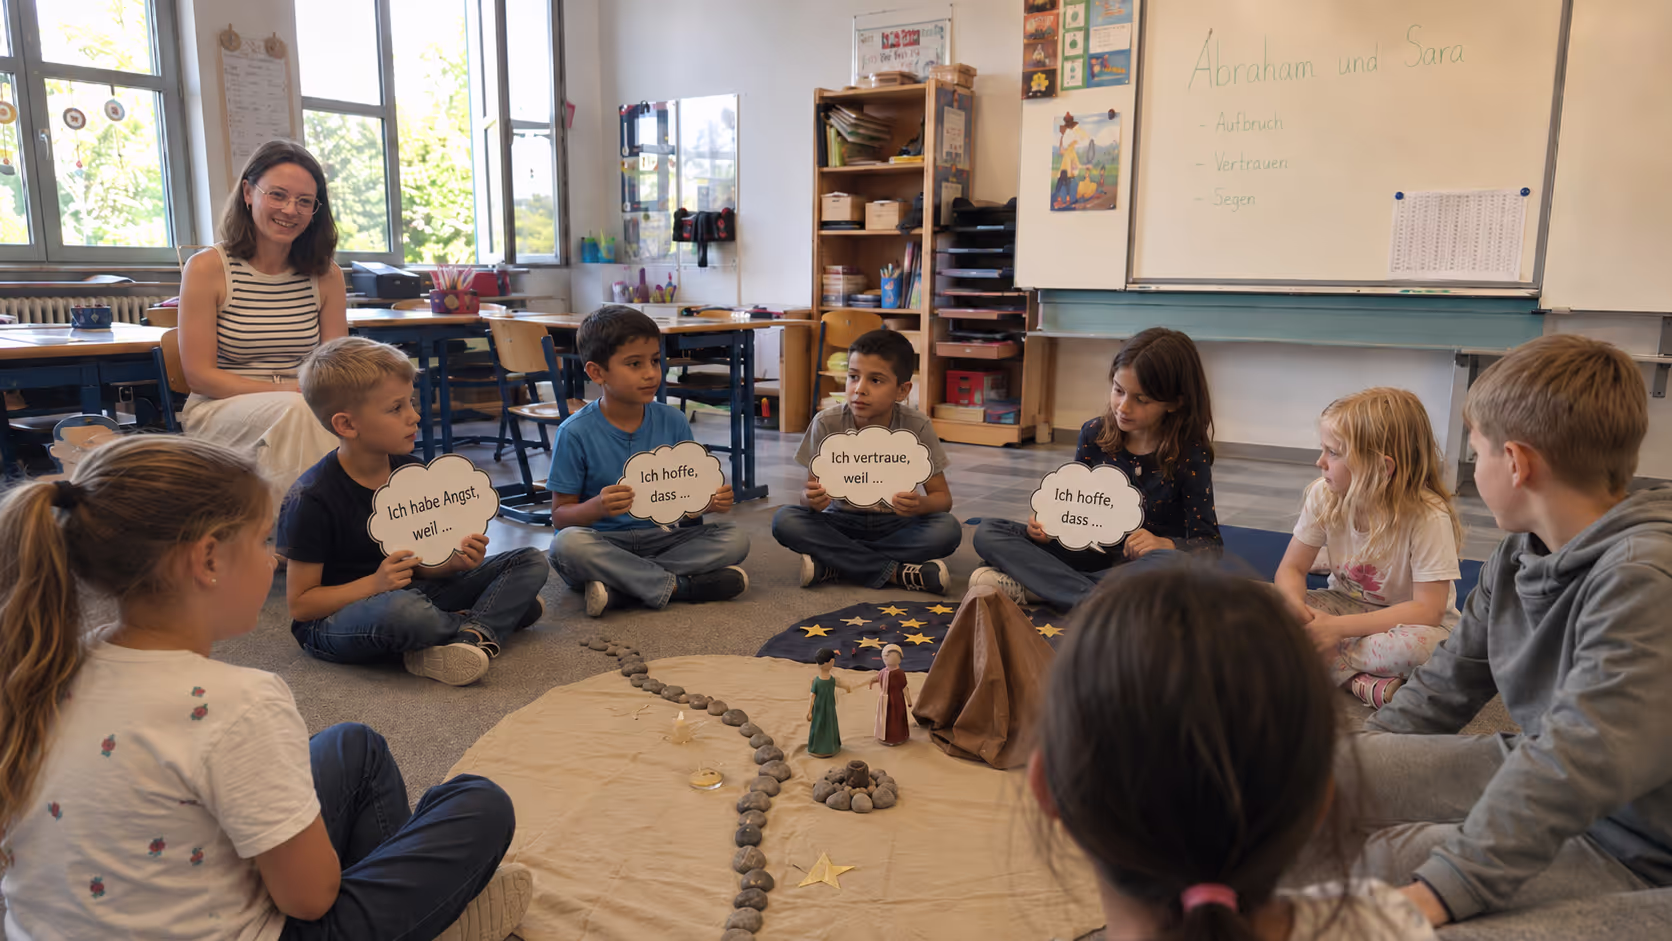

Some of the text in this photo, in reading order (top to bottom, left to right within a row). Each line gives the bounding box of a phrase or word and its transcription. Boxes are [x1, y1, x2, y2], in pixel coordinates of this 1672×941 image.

[1188, 24, 1465, 91] Abraham und Sara
[1215, 110, 1284, 133] Aufbruch
[1214, 151, 1289, 172] Vertrauen
[1212, 187, 1256, 213] Segen
[831, 451, 911, 465] Ich vertraue,
[640, 464, 698, 484] Ich hoffe,
[843, 471, 869, 484] weil
[387, 485, 480, 520] Ich habe Angst,
[650, 489, 677, 503] dass
[1054, 487, 1114, 510] Ich hoffe,
[1061, 510, 1089, 526] dass
[412, 520, 438, 541] weil
